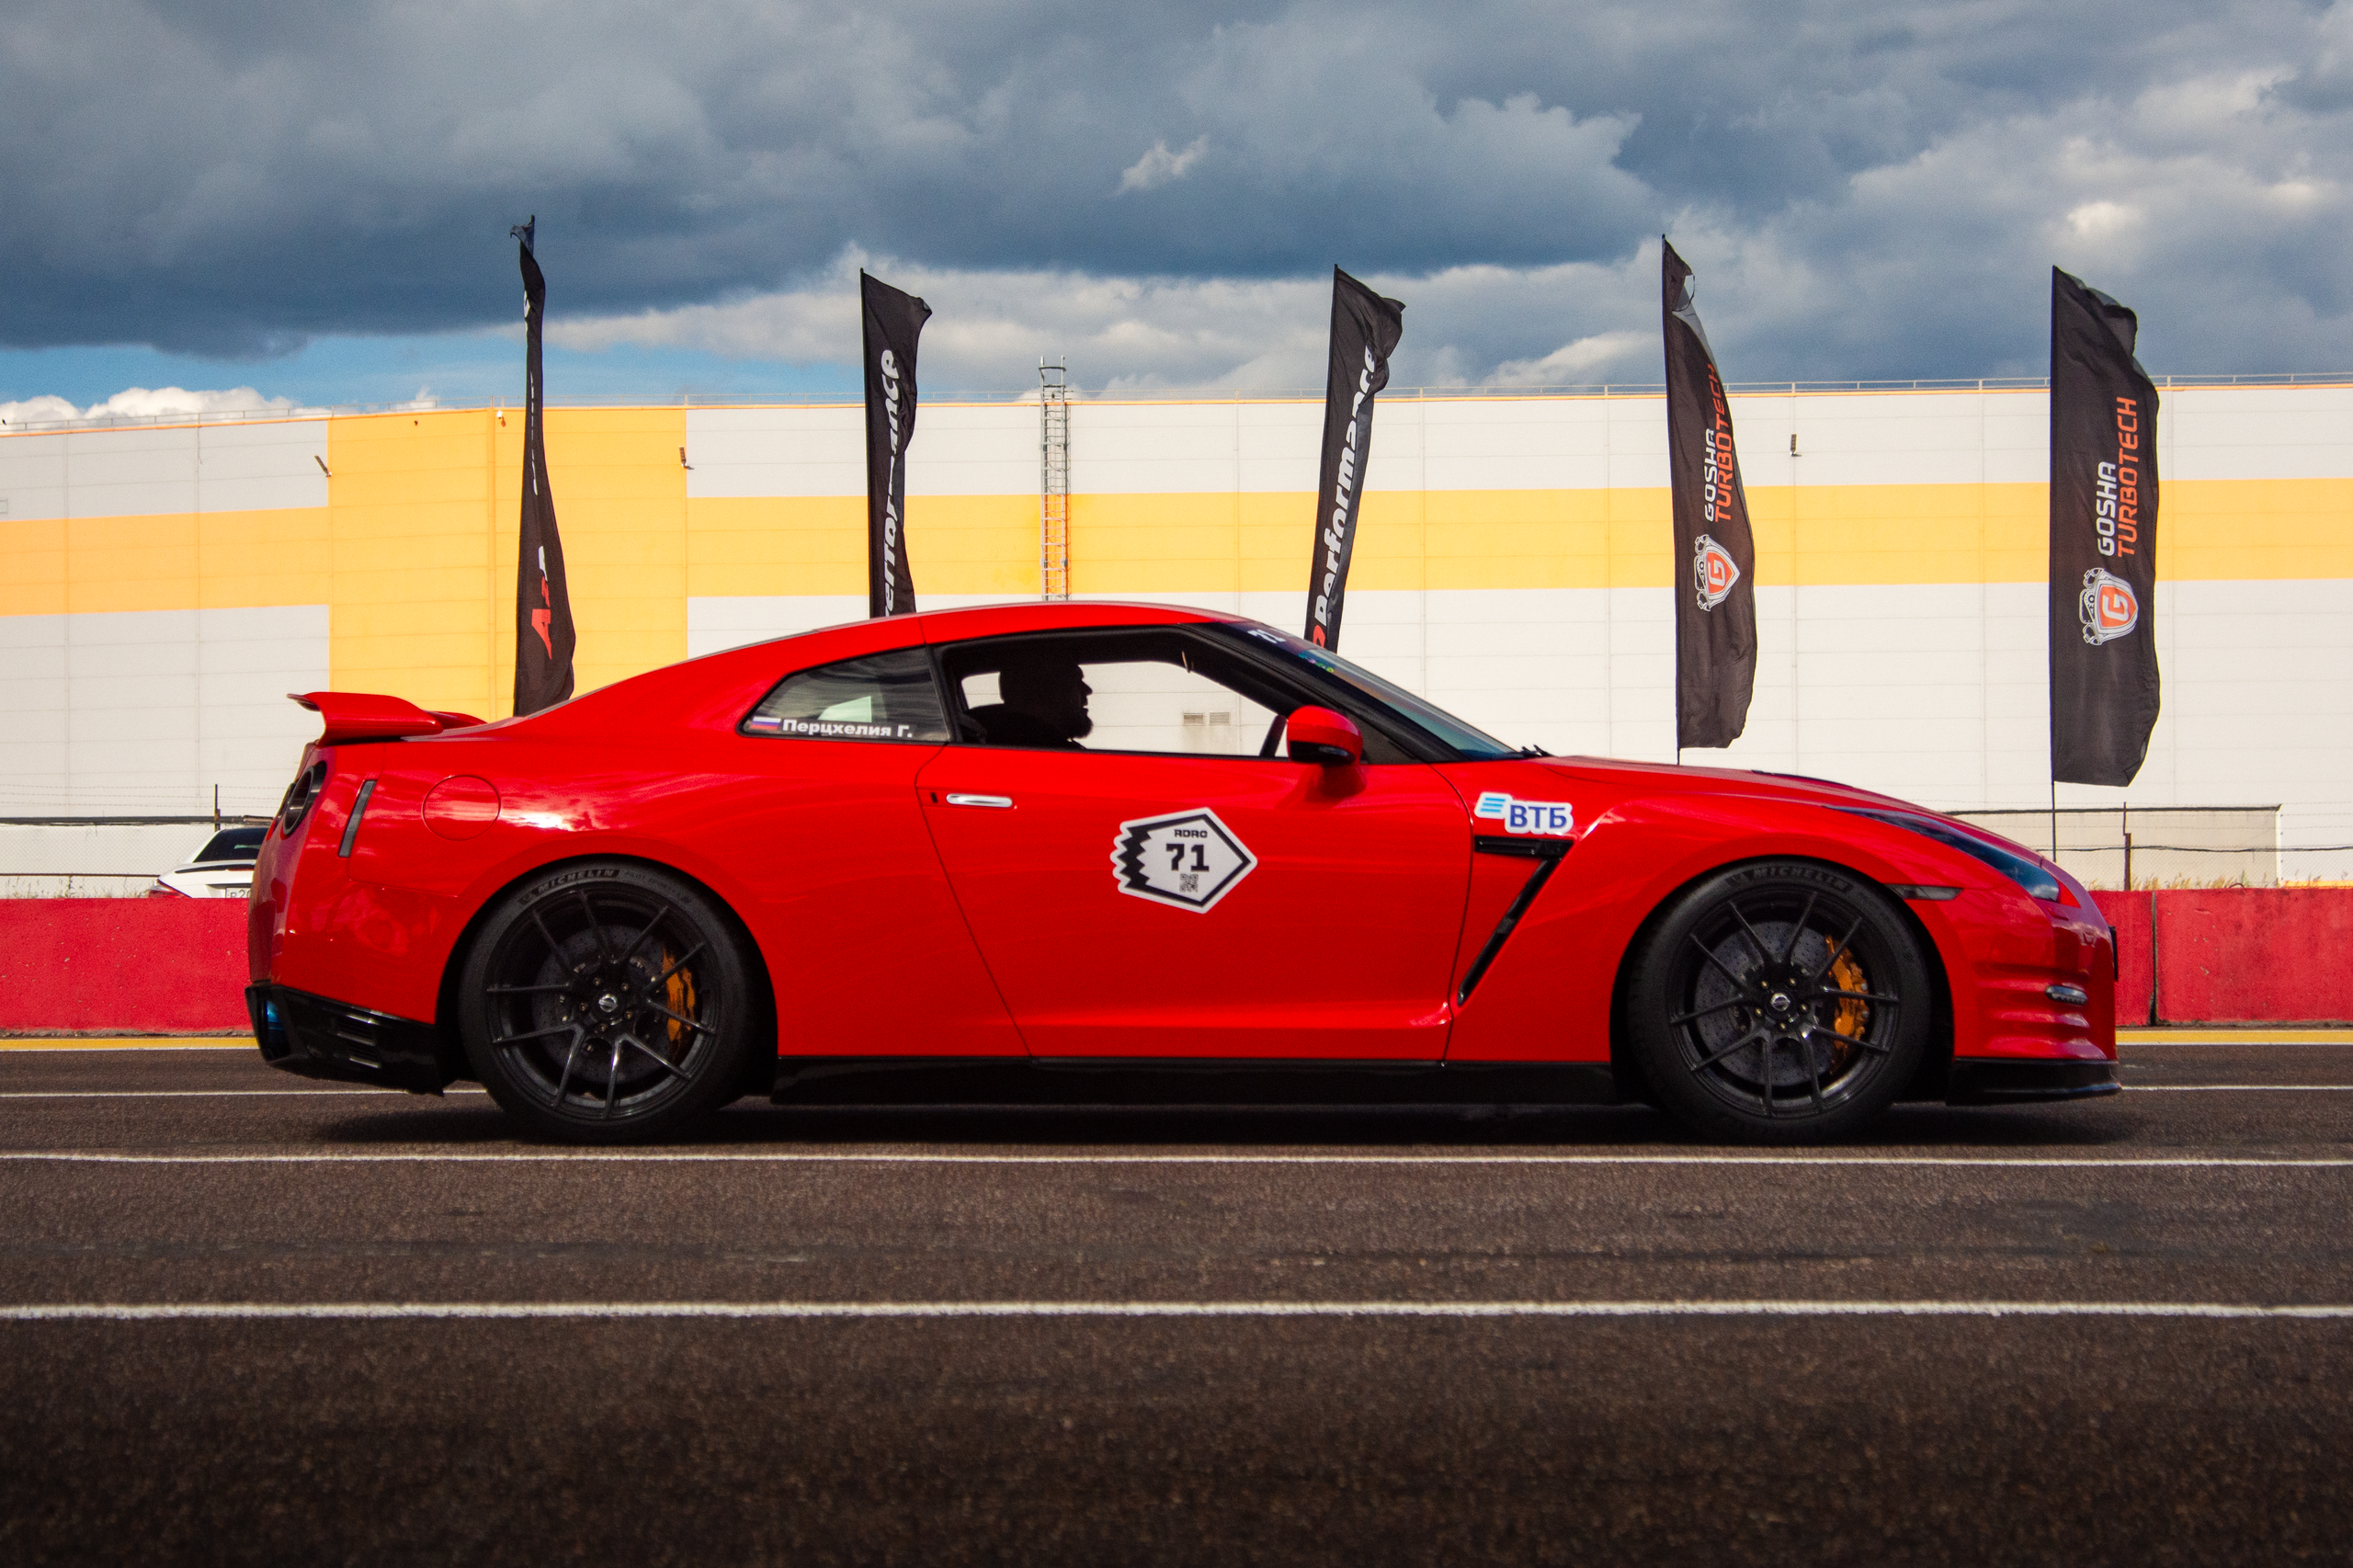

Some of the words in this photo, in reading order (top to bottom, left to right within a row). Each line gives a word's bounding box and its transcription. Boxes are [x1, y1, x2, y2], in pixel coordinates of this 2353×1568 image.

[1708, 363, 1733, 523] TURBOTECH
[1704, 427, 1718, 523] GOSHA
[2116, 396, 2139, 558] TURBOTECH
[2096, 461, 2118, 557] GOSHA
[782, 719, 892, 737] Перцхелия
[897, 724, 914, 737] Г.
[1509, 804, 1567, 829] ВТБ
[1174, 829, 1208, 838] RDRC
[1165, 843, 1210, 872] 71
[538, 869, 616, 894] MICHELIN
[1753, 866, 1848, 890] MICHELIN
